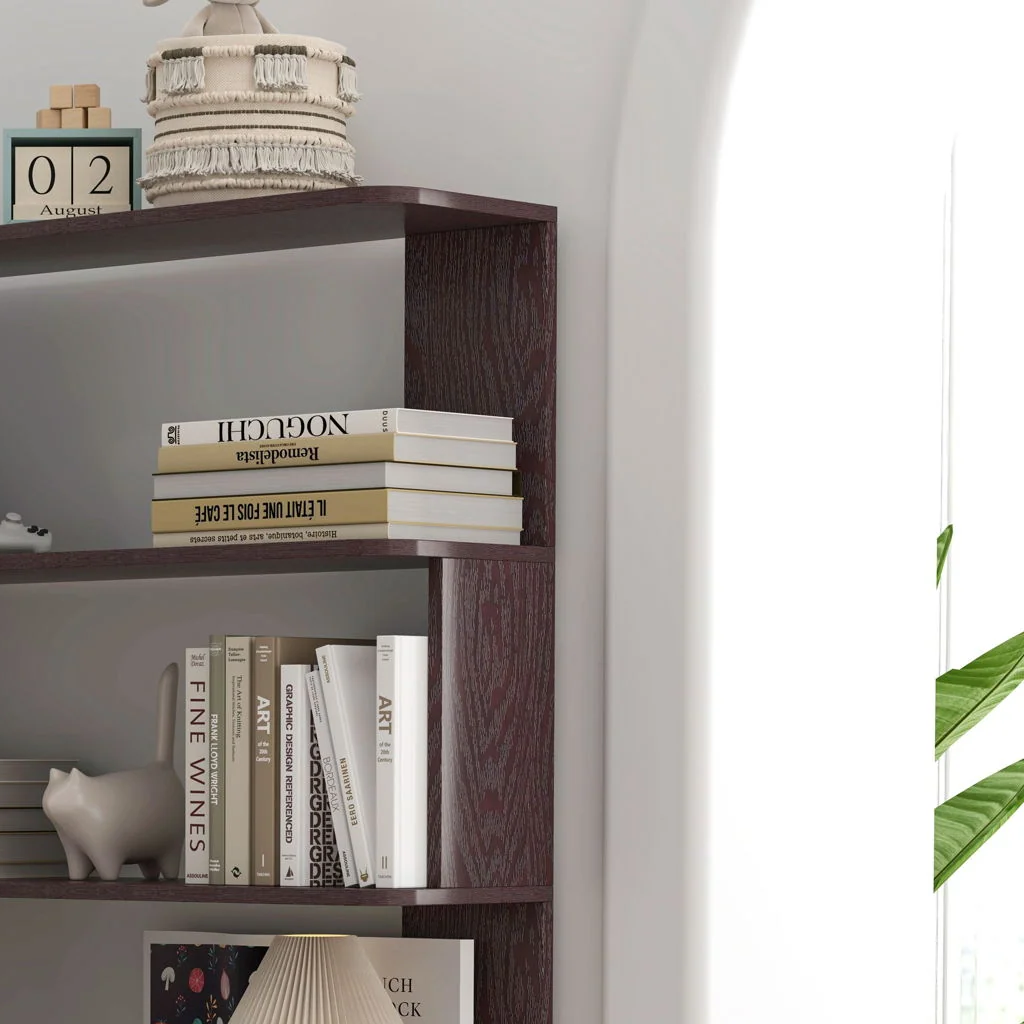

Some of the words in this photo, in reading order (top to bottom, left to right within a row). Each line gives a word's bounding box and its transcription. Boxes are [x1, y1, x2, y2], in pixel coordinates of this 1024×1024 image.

[40, 205, 102, 218] August
[217, 414, 349, 443] NOGUCHI
[236, 447, 319, 465] Remodelista
[195, 505, 220, 526] CAFÉ
[223, 504, 234, 520] LE
[238, 503, 260, 520] FOIS
[263, 502, 282, 519] UNE
[286, 500, 314, 520] ÉTAIT
[317, 500, 326, 516] IL
[218, 534, 237, 542] petits
[190, 681, 205, 743] FINE
[257, 696, 270, 734] ART
[379, 696, 392, 734] ART
[323, 757, 338, 812] BORDEAUX
[339, 757, 355, 800] SAARINEN
[190, 758, 205, 851] WINES
[345, 803, 357, 826] EERO
